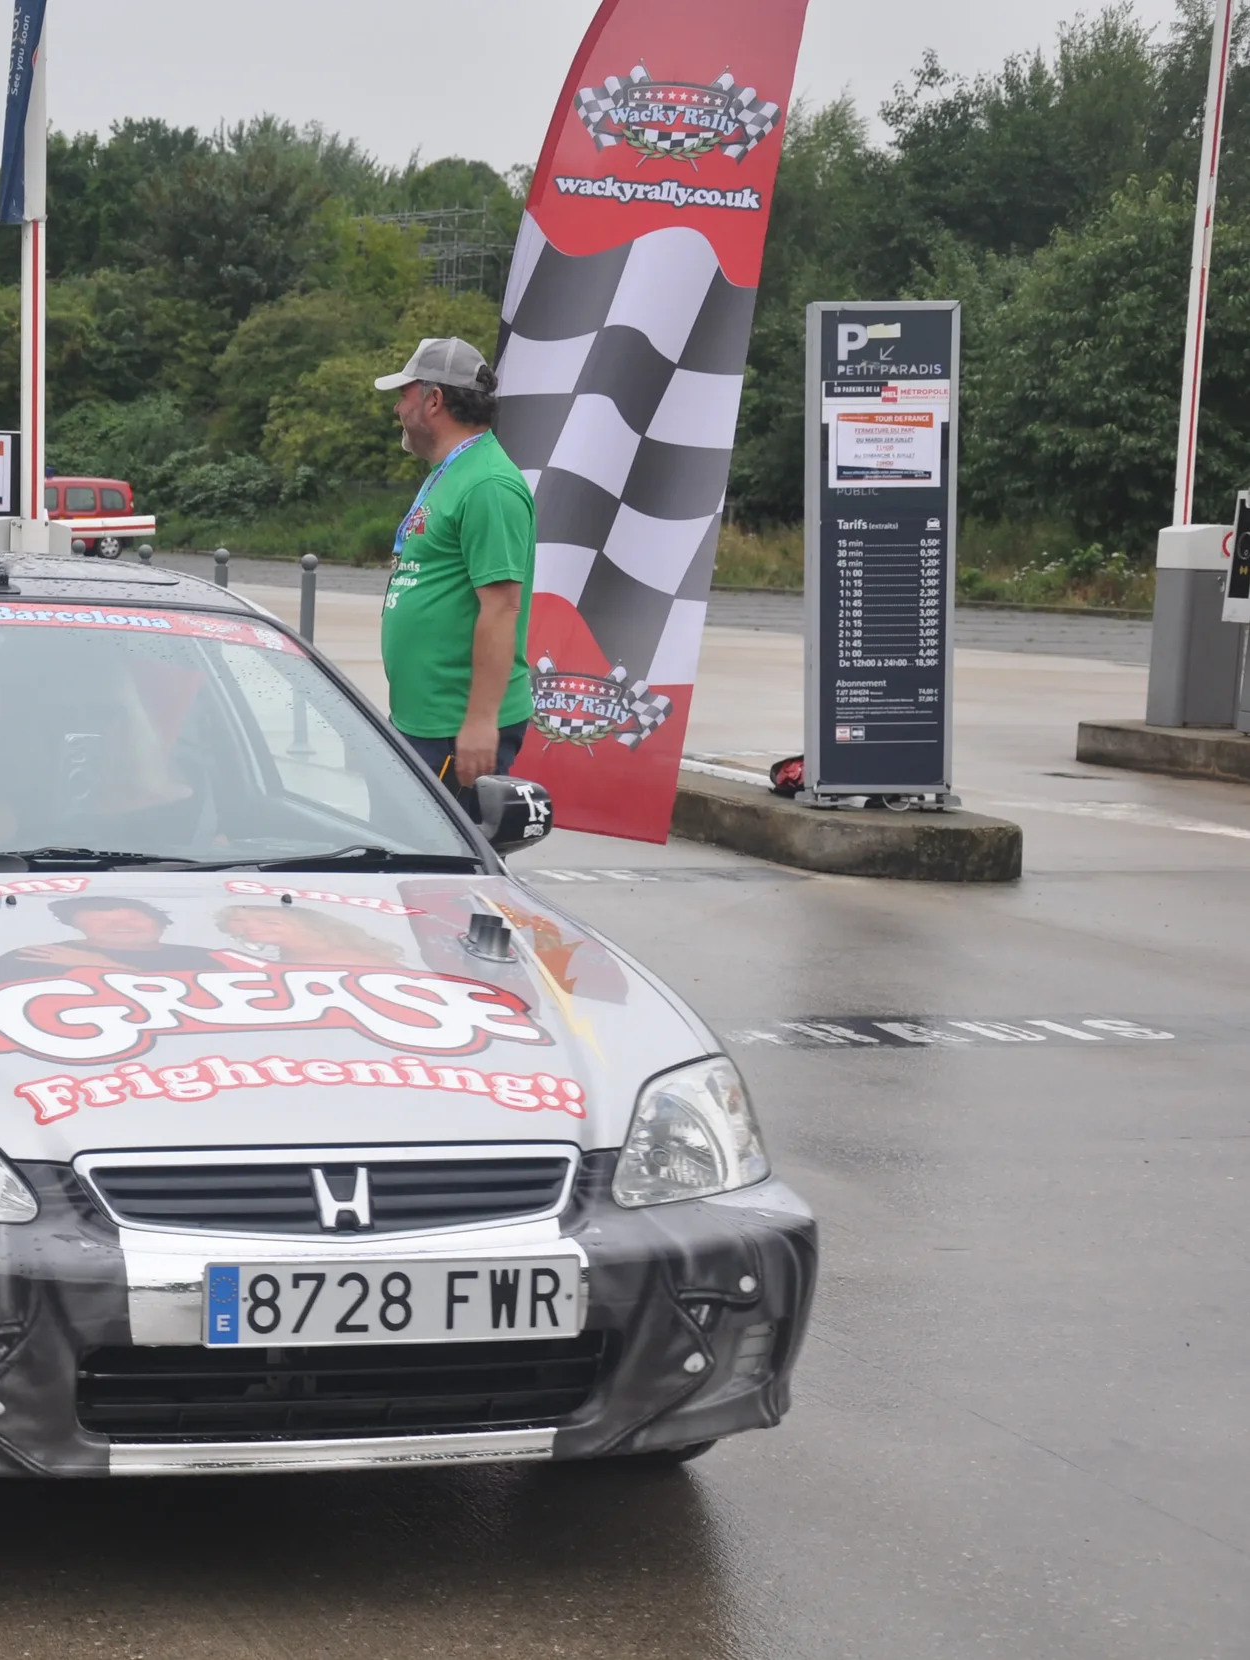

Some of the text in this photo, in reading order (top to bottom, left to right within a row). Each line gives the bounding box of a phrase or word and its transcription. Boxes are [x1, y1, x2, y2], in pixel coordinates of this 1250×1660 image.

[20, 14, 31, 45] soon
[16, 47, 25, 71] you
[10, 73, 21, 96] See
[608, 104, 742, 136] Wacky Rally
[554, 176, 762, 210] wackyrally.co.uk
[837, 323, 869, 361] P
[837, 363, 942, 376] PETIT PARADIS
[900, 387, 948, 395] MÉTROPOLE
[836, 519, 899, 531] Tarifs (extraits)
[839, 579, 844, 587] 1
[845, 579, 851, 587] h
[852, 579, 862, 587] 15
[839, 589, 844, 597] 1
[845, 589, 851, 597] h
[852, 589, 862, 597] 30
[839, 599, 844, 607] 1
[845, 599, 851, 607] h
[852, 599, 862, 607] 45
[839, 659, 850, 667] De
[852, 659, 876, 667] 12h00
[877, 659, 882, 667] à
[883, 659, 907, 667] 24h00
[581, 696, 633, 725] Rally
[523, 824, 544, 838] BIRDS
[224, 880, 427, 916] Sandy
[15, 1055, 586, 1126] Frightening!!
[246, 1267, 561, 1335] 8728 FWR
[216, 1313, 231, 1332] E
